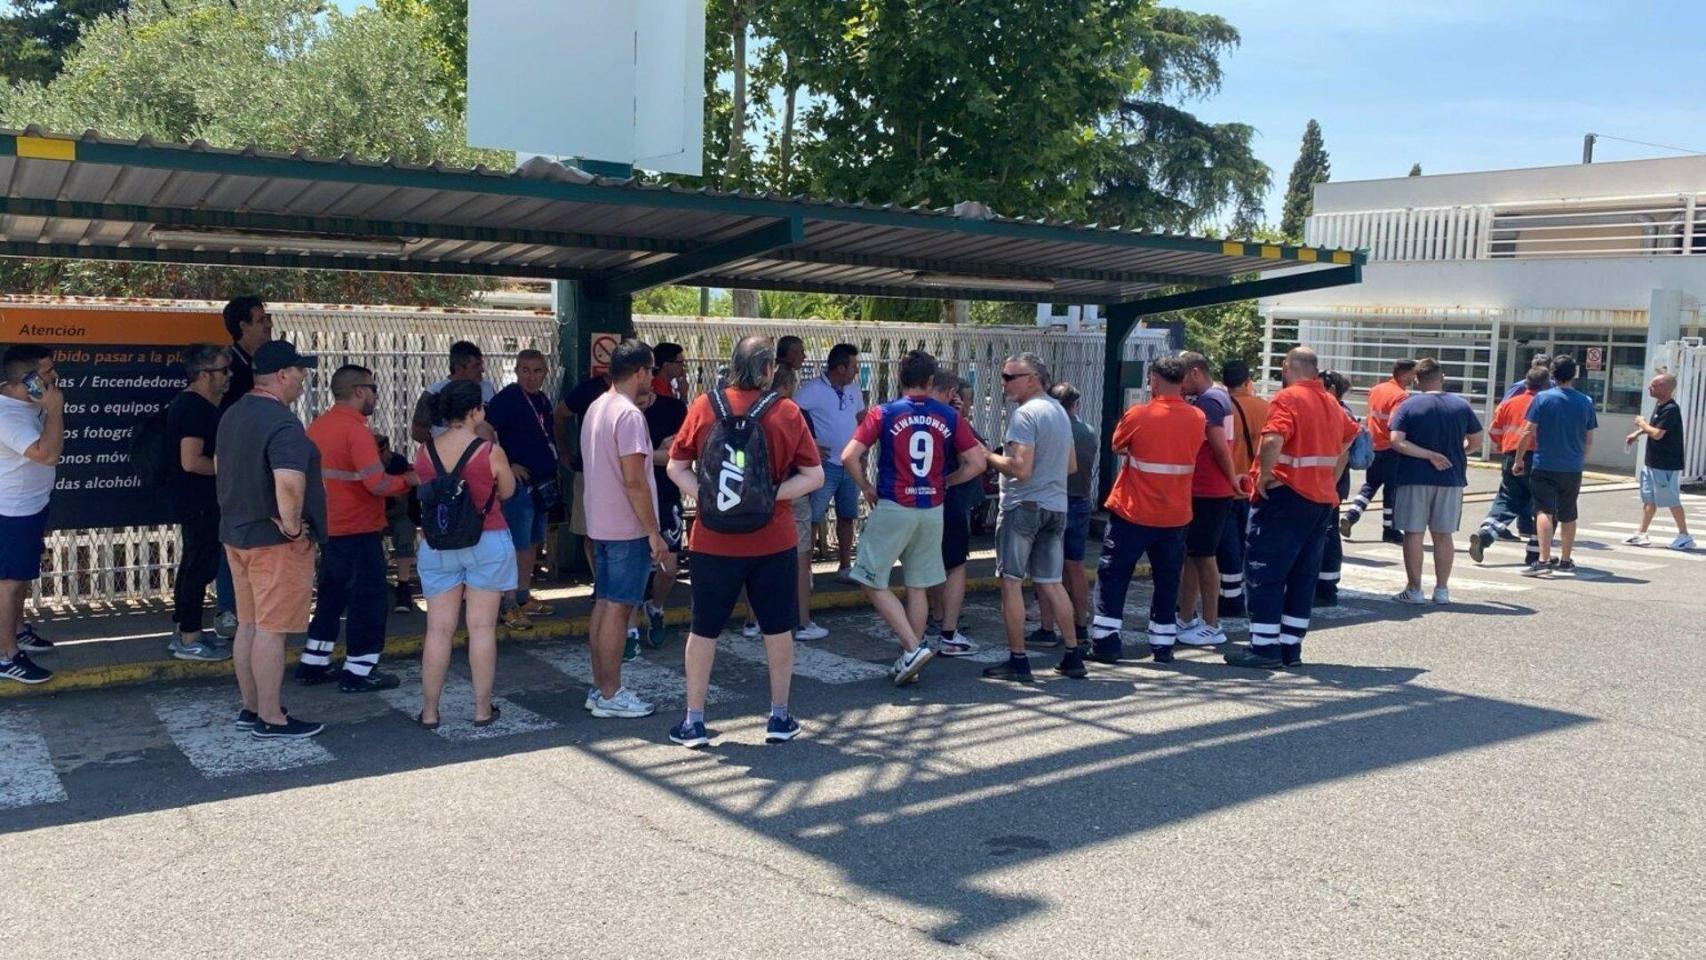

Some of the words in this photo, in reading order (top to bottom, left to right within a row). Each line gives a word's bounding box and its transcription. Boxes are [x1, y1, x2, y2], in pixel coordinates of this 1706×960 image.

[19, 324, 86, 337] Atención
[53, 351, 90, 363] ibido
[94, 353, 132, 366] pasar
[137, 353, 146, 362] a
[150, 351, 163, 362] la
[91, 375, 188, 389] Encendedores
[90, 404, 100, 414] o
[104, 401, 160, 416] equipos
[890, 416, 951, 439] LEWANDOWSKI
[909, 430, 934, 478] 9
[717, 443, 745, 512] FILA
